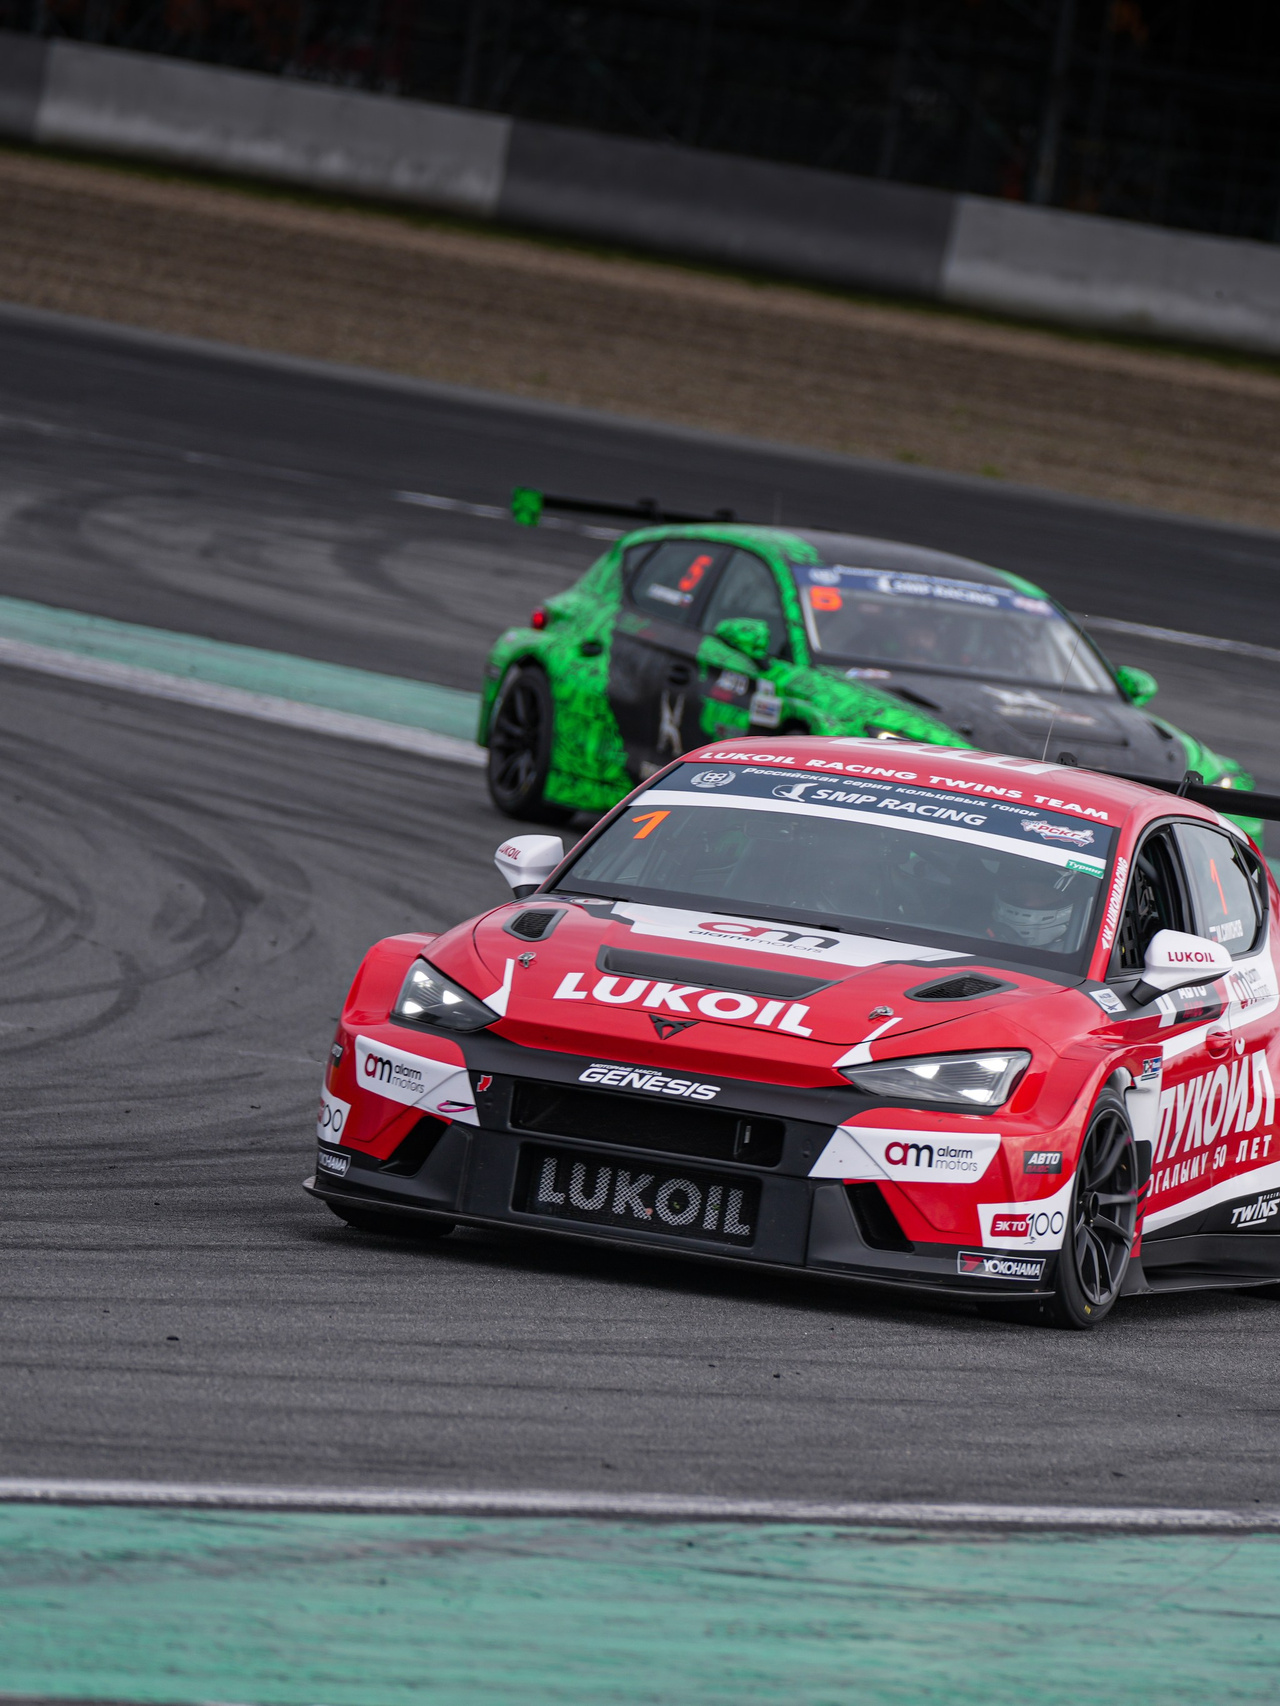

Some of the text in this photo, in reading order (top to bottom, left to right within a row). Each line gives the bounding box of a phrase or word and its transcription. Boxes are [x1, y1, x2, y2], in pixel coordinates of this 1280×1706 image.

[699, 752, 796, 765] LUKOIL
[805, 758, 918, 780] RACING
[929, 775, 1023, 799] TWINS
[1034, 794, 1109, 821] TEAM
[742, 767, 1039, 817] Российская серия кольцевых гонок
[810, 789, 988, 826] SMP RACING
[631, 810, 672, 840] 1
[1069, 860, 1103, 875] Туринг
[1209, 858, 1228, 915] 1
[1168, 951, 1215, 963] LUKOIL
[552, 972, 813, 1037] LUKOIL
[391, 1076, 425, 1094] motors
[394, 1063, 423, 1081] alarm
[578, 1067, 721, 1100] GENESIS
[935, 1158, 978, 1172] motors
[937, 1145, 973, 1160] alarm
[1147, 1134, 1273, 1197] ОГАЛЫМУ 50 ЛЕТ
[538, 1157, 750, 1236] LUKOIL
[1231, 1195, 1280, 1224] TWINS
[983, 1258, 1041, 1277] YOKOHAMA
